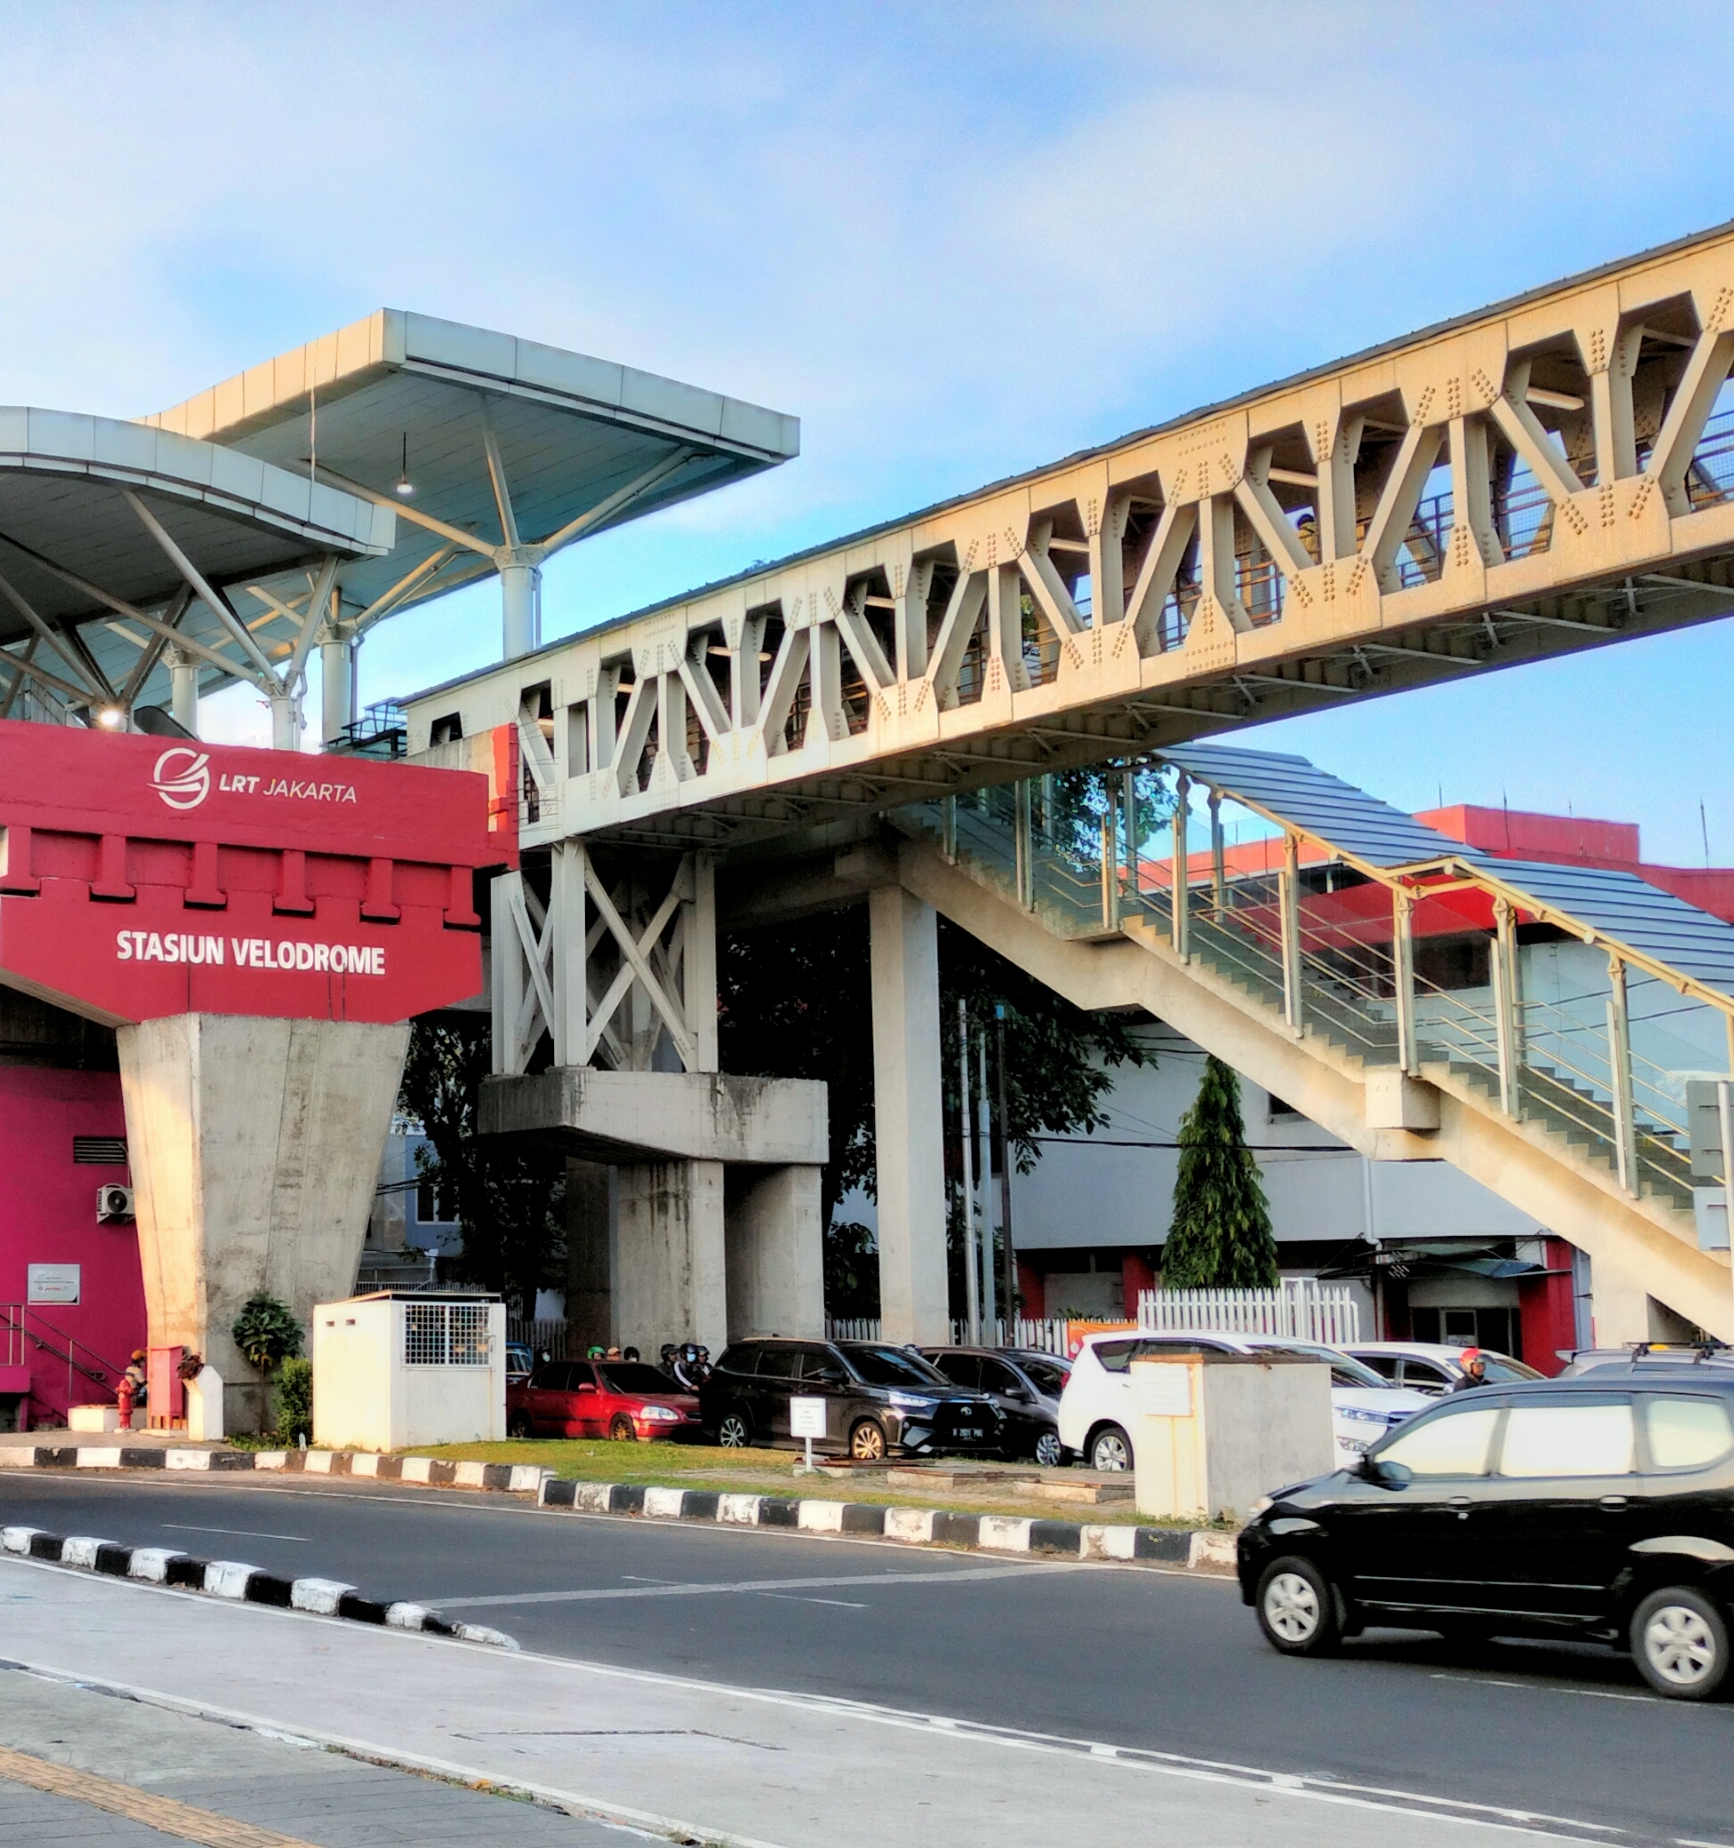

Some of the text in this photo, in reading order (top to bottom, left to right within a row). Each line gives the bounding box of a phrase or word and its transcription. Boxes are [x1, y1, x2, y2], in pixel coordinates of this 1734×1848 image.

[219, 773, 357, 804] LRT JAKARTA
[116, 930, 386, 976] STASIUN VELODROME
